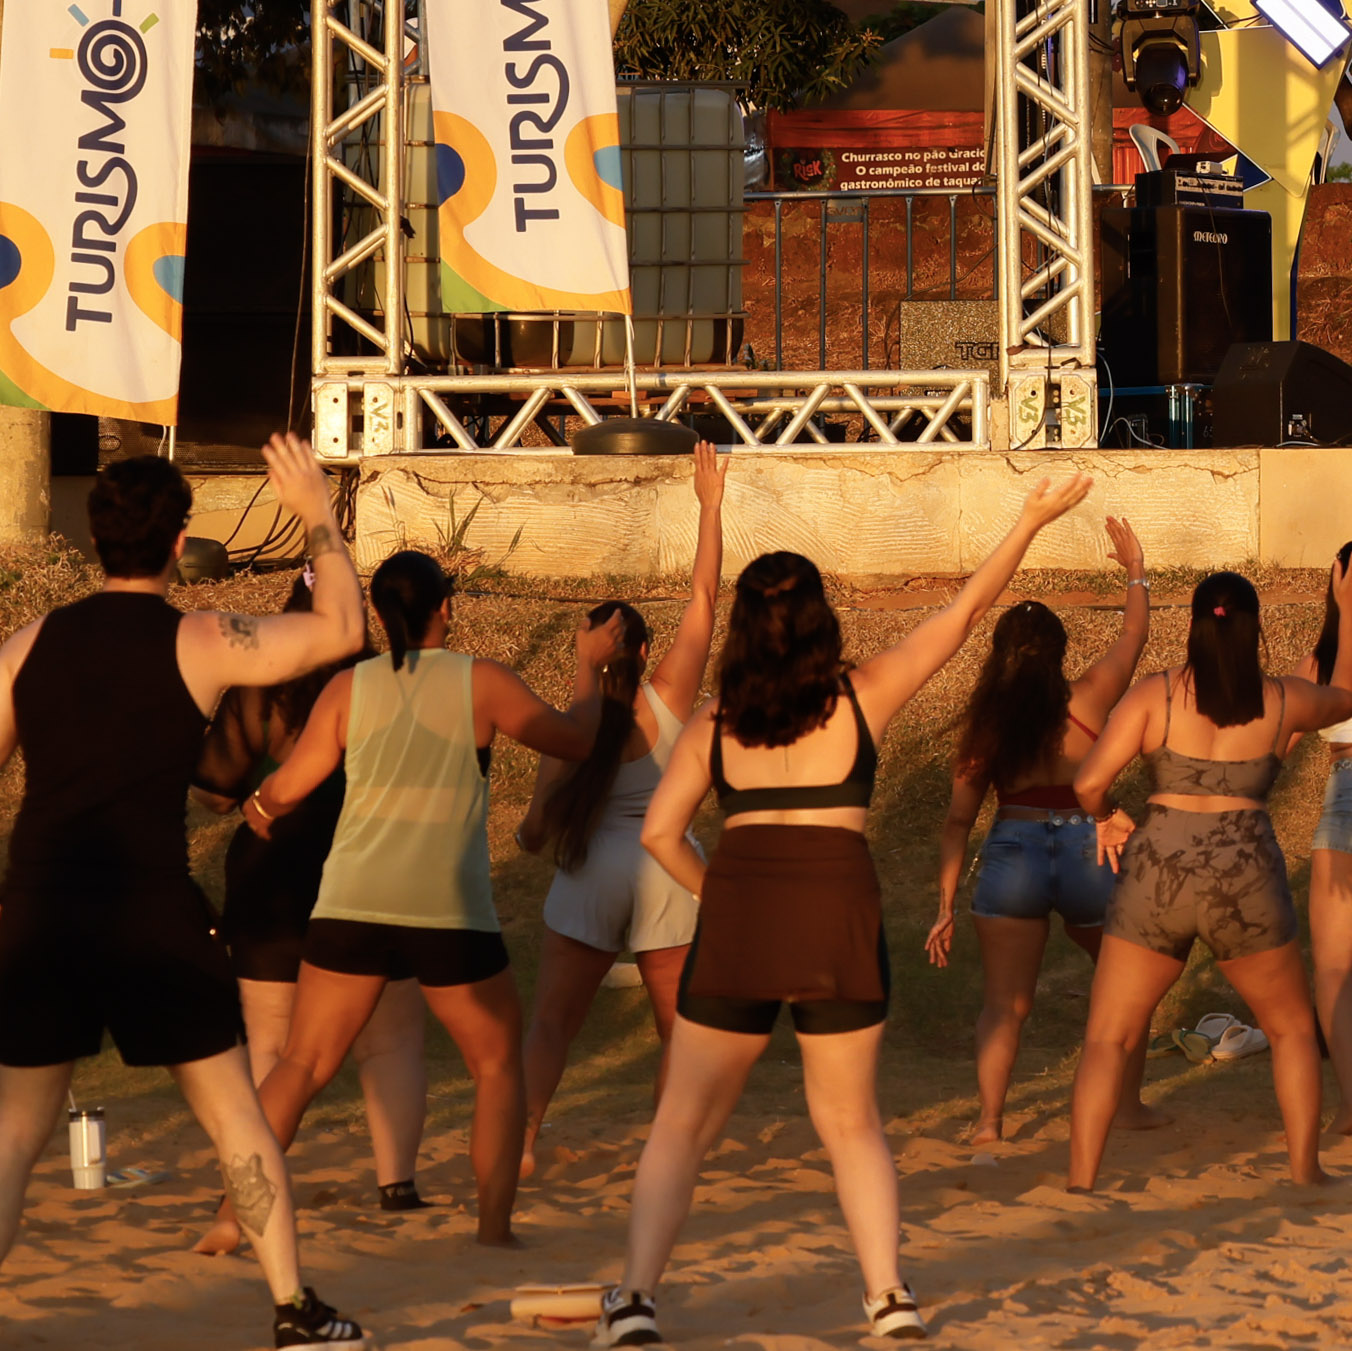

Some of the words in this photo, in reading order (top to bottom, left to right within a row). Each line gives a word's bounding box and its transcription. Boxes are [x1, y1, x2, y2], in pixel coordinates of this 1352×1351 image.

[841, 152, 902, 162] Churrasco
[923, 150, 946, 162] pão
[65, 19, 148, 332] TURISMO
[856, 166, 866, 175] O
[869, 164, 923, 177] campeão
[926, 162, 969, 173] festival
[840, 178, 923, 191] gastronômico
[925, 177, 941, 187] de
